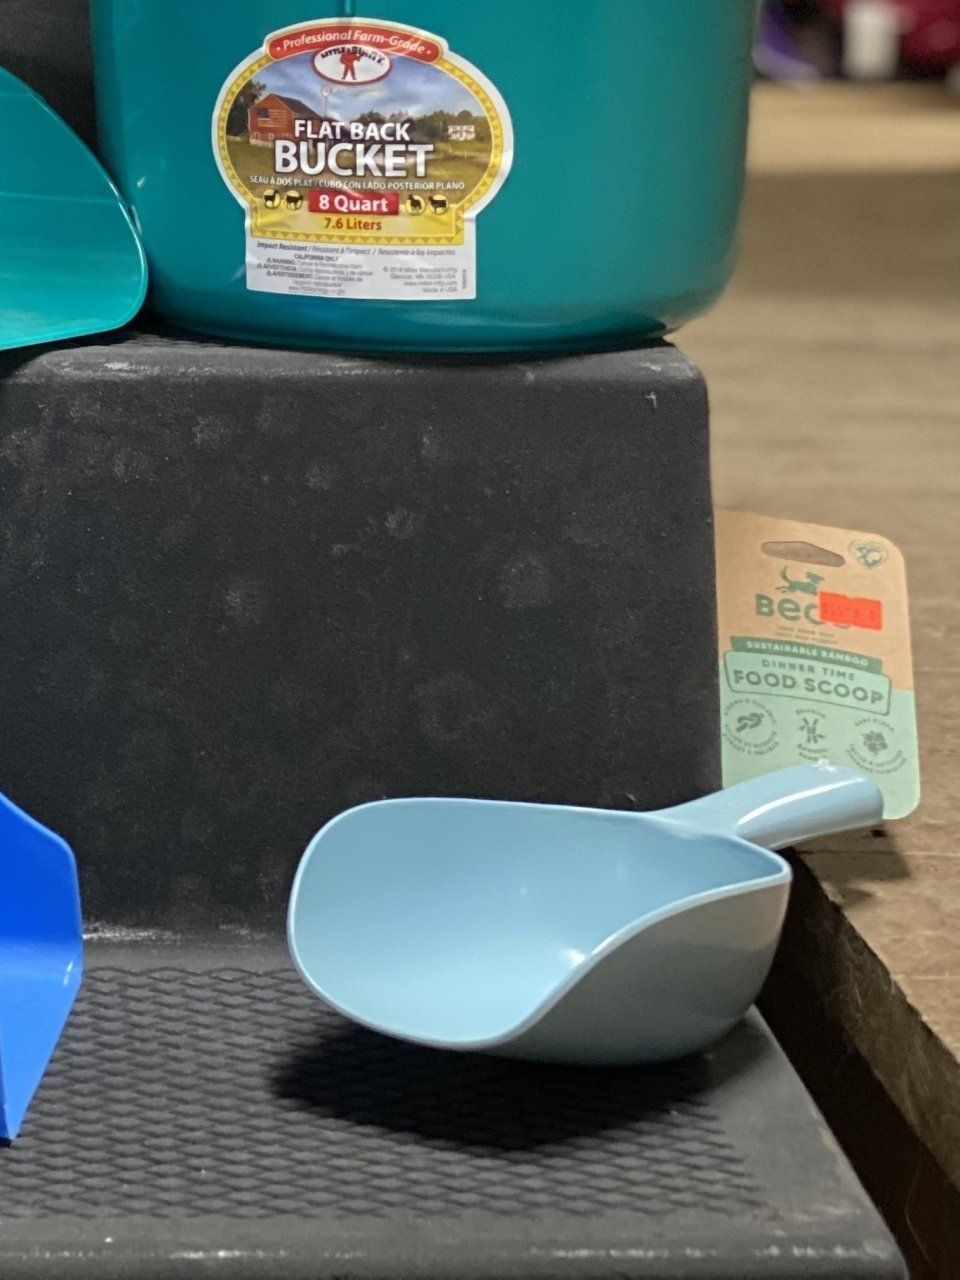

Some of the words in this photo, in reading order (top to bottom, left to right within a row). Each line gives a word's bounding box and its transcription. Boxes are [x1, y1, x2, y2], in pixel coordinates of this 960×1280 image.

[283, 30, 352, 50] Professional
[354, 30, 426, 54] Farm-Grade
[294, 119, 345, 140] FLAT
[350, 122, 411, 142] BACK
[274, 139, 434, 178] BUCKET
[249, 175, 269, 184] SEAU
[276, 177, 293, 186] DOS
[293, 179, 313, 187] PLAT
[319, 180, 342, 189] CUBO
[343, 180, 362, 189] CON
[362, 181, 387, 190] LADO
[387, 181, 435, 190] POSTERIOR
[436, 181, 465, 190] PLANO
[319, 195, 330, 210] 8
[333, 195, 388, 212] Quart
[324, 217, 343, 229] 7.6
[347, 218, 382, 231] Liters
[257, 241, 278, 249] Impact
[279, 242, 308, 251] Resistant
[378, 248, 410, 256] Resistente
[746, 640, 818, 657] SUSTAINABLE
[820, 649, 870, 667] BAMBOO
[762, 659, 816, 674] DINNER
[821, 667, 856, 681] TIME
[733, 669, 797, 689] FOOD
[804, 677, 884, 704] SCOOP
